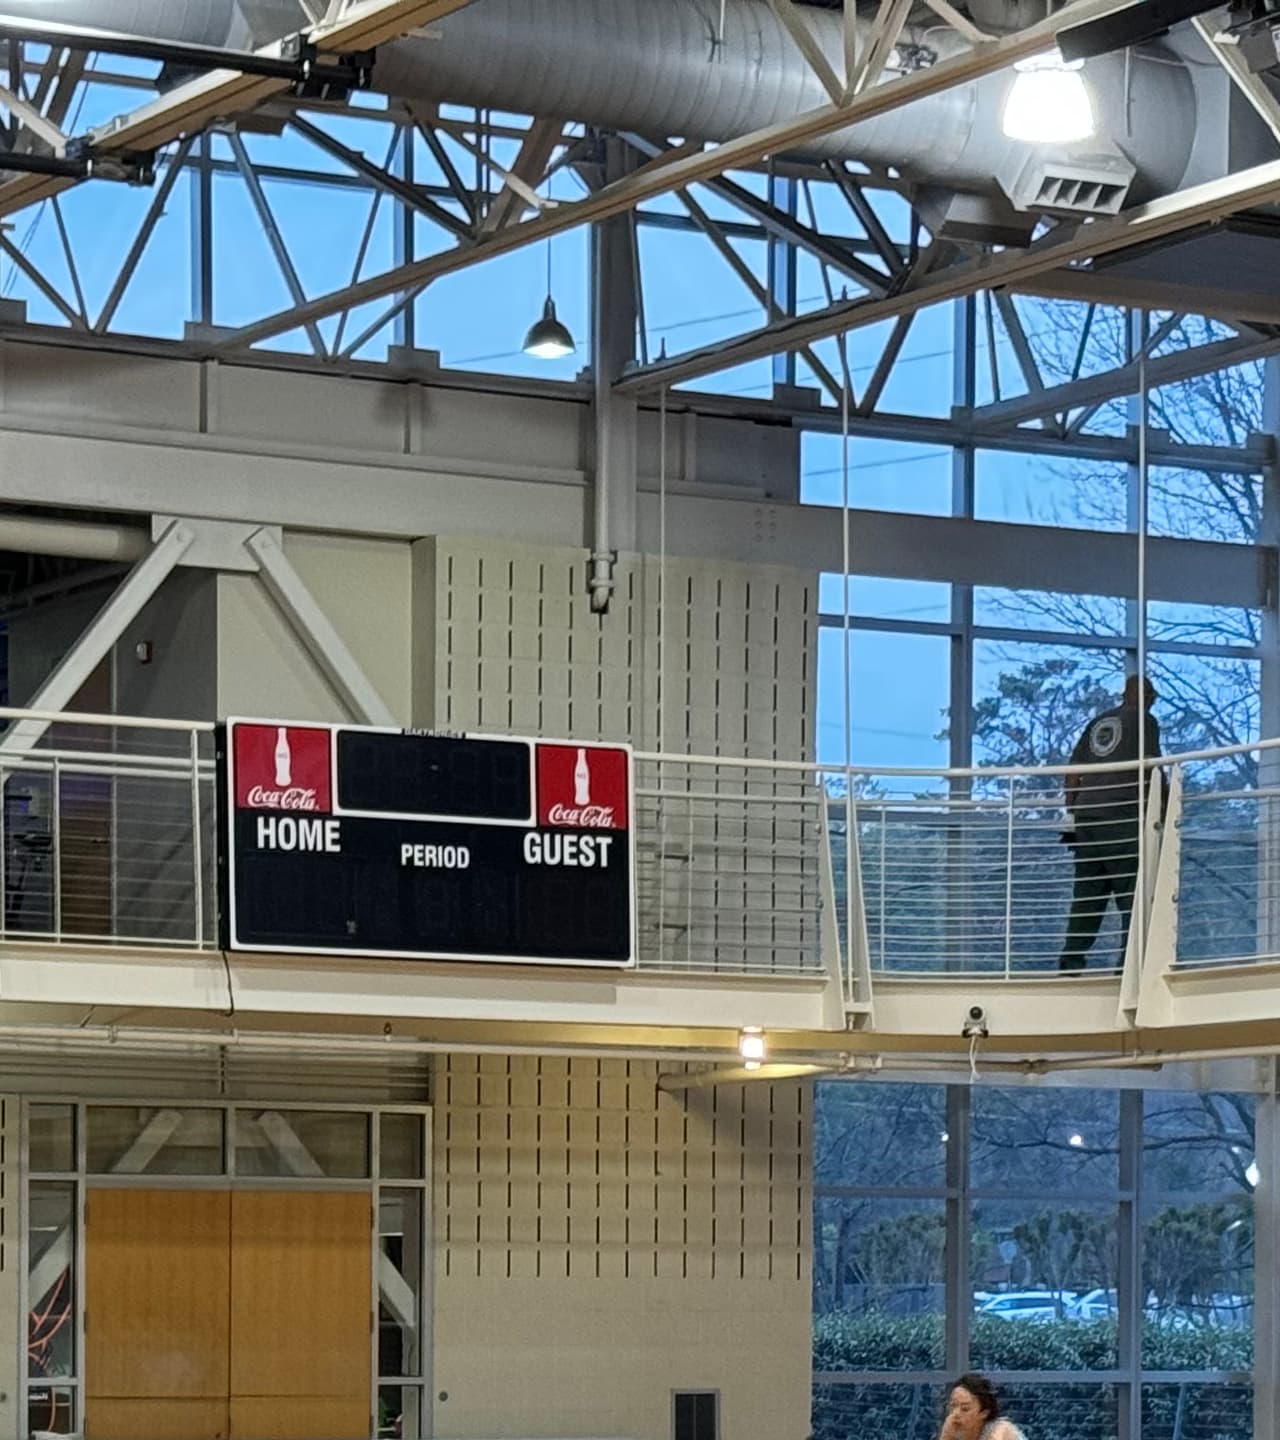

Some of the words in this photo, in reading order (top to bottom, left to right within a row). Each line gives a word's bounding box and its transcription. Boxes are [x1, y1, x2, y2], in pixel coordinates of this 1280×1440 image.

[257, 816, 341, 852] HOME
[523, 832, 612, 867] GUEST
[401, 844, 470, 869] PERIOD
